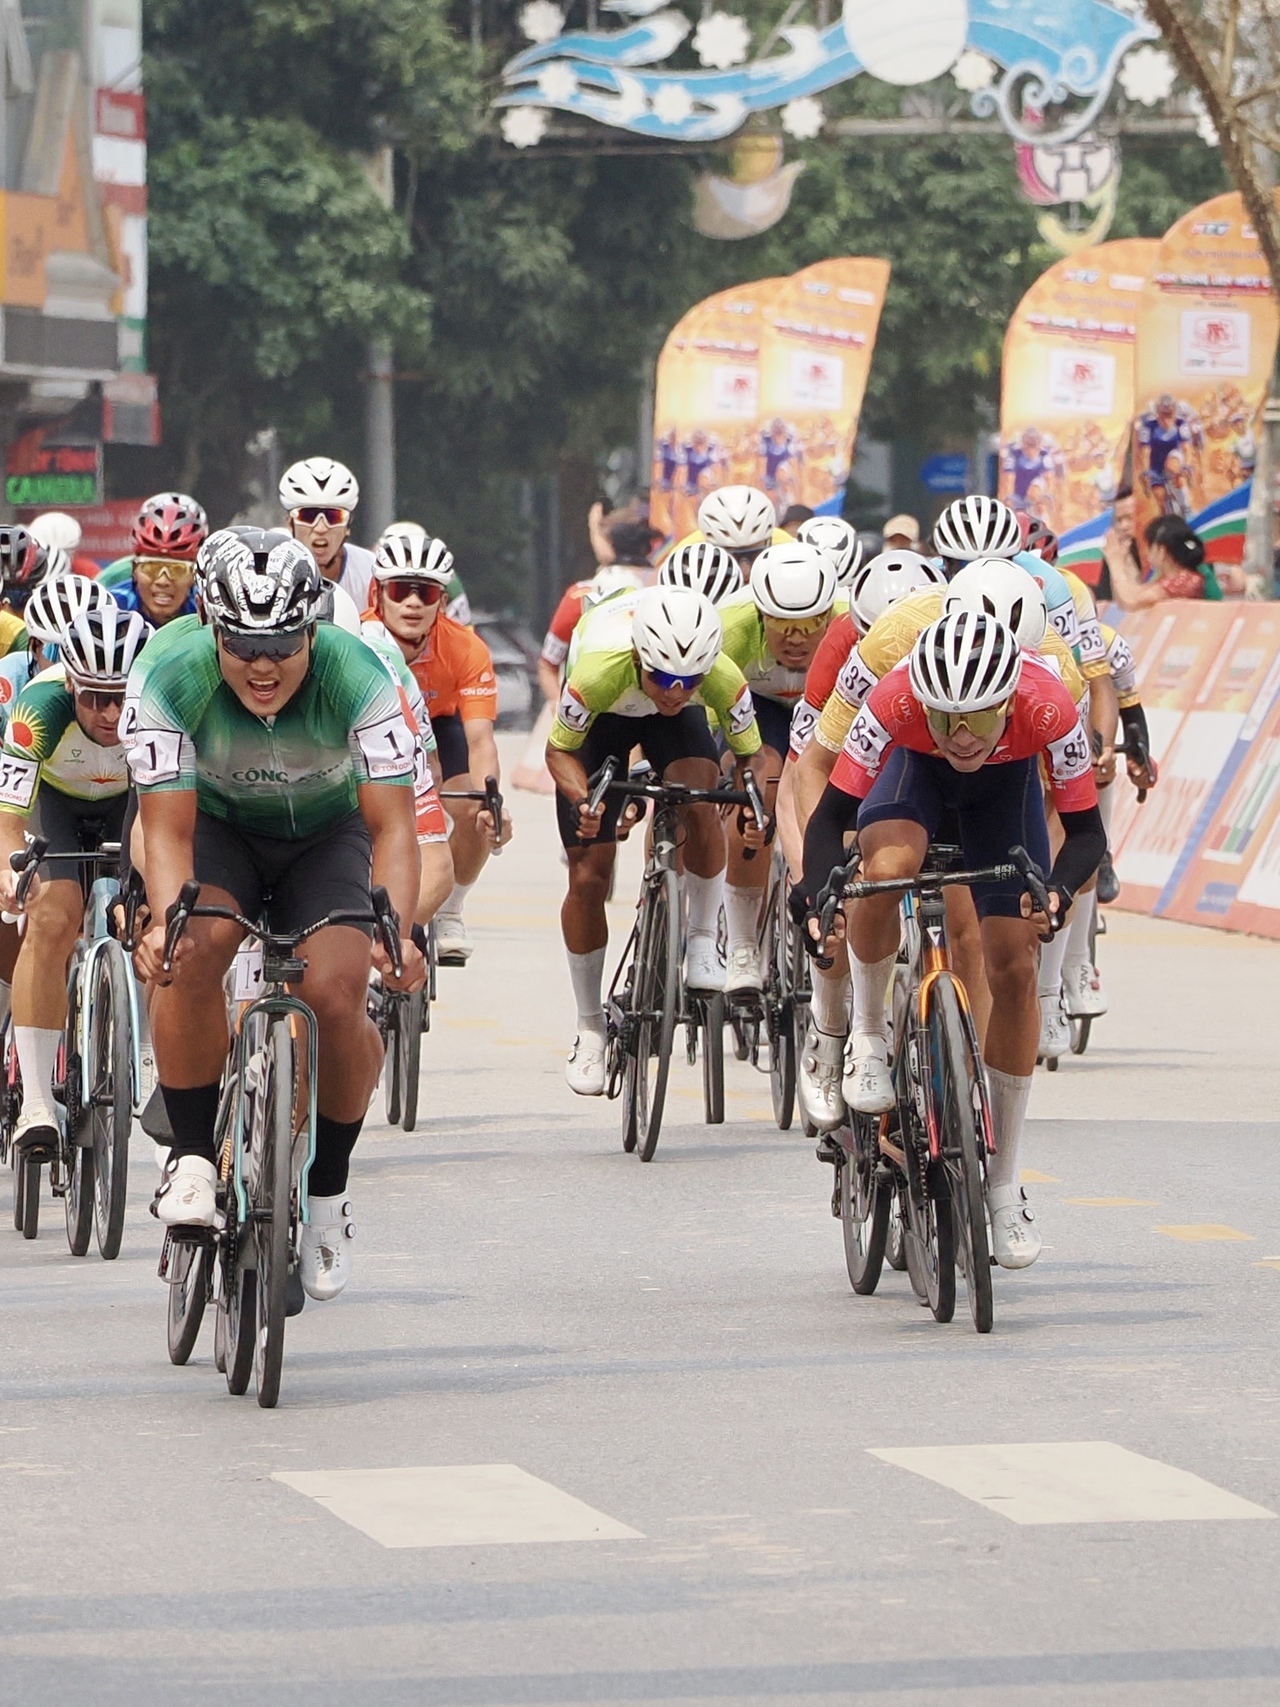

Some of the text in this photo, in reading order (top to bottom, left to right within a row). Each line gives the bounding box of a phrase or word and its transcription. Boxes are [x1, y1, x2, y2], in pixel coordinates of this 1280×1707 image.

[1081, 626, 1103, 651] 53
[791, 706, 814, 740] 12
[1037, 705, 1056, 732] VDC
[384, 730, 405, 760] 1
[850, 716, 878, 752] 85
[145, 741, 157, 770] 1
[232, 767, 289, 784] CÔNG
